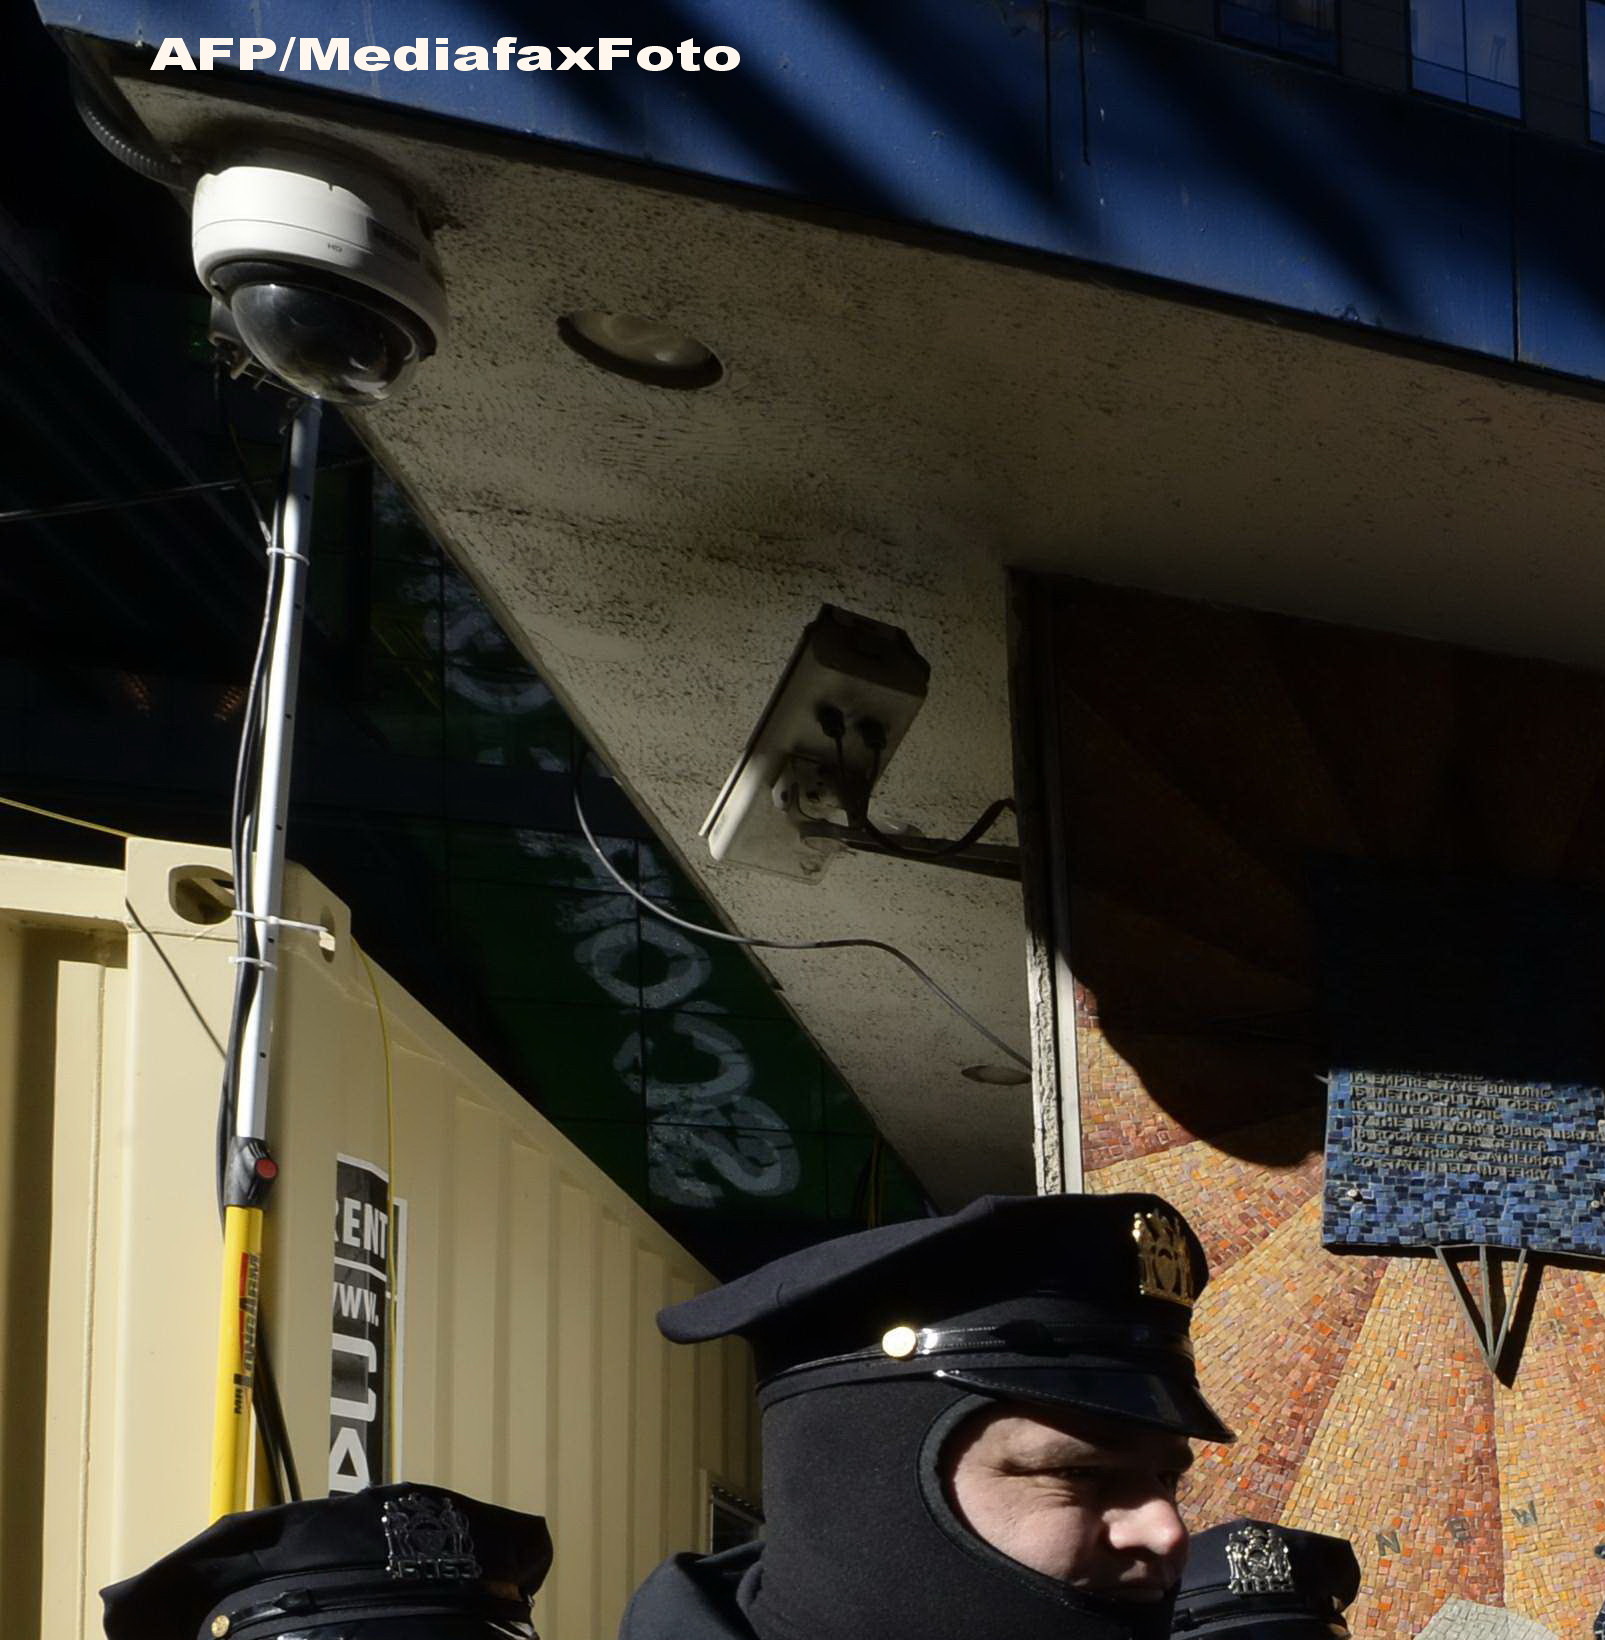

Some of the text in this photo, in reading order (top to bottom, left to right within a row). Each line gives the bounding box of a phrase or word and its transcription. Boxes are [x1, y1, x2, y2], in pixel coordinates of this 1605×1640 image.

[1373, 1088, 1499, 1108] METROPOLITAN
[1507, 1099, 1559, 1112] OPERA
[1375, 1102, 1432, 1116] UNITED
[1494, 1125, 1547, 1138] PUBLIC
